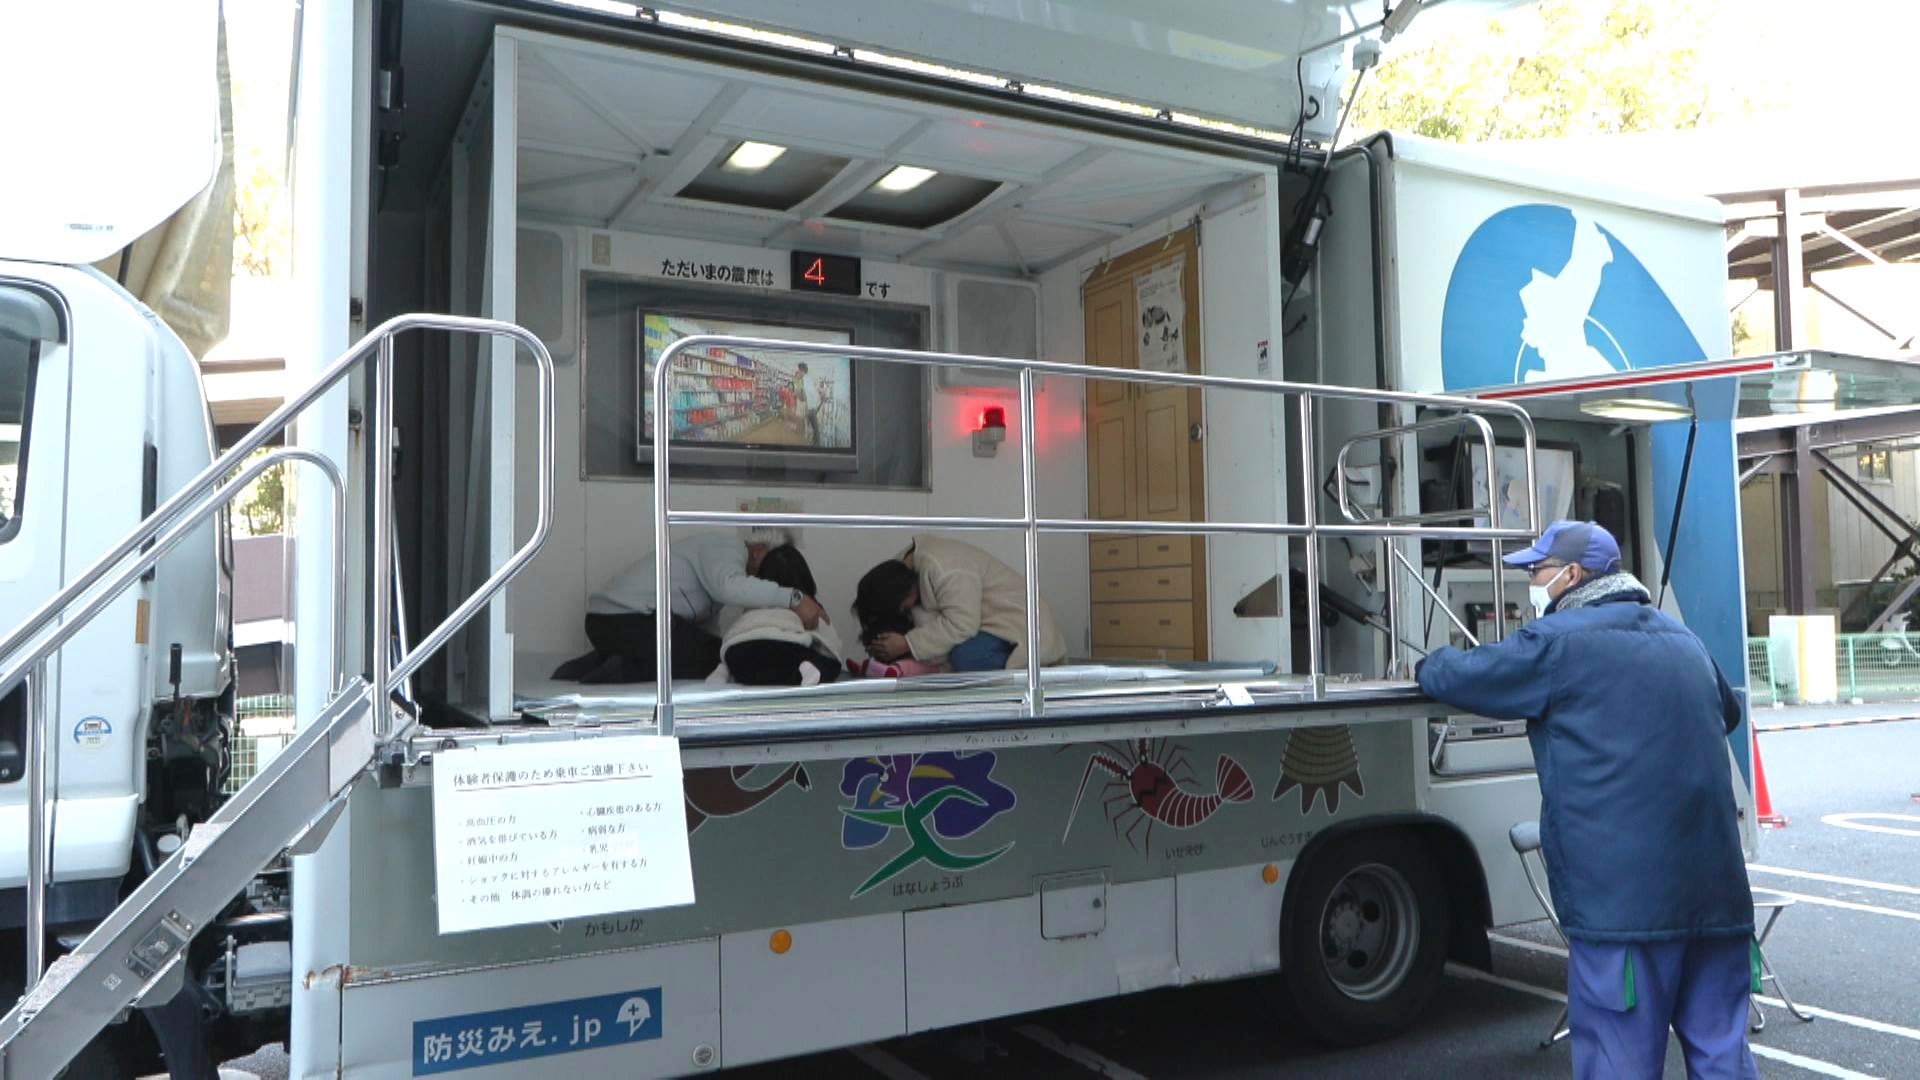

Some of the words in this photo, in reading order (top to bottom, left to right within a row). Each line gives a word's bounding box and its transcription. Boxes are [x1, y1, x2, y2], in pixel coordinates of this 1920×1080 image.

[662, 258, 774, 287] ただいまの震度は
[803, 256, 825, 287] 4
[866, 282, 891, 299] です
[453, 762, 650, 787] 体験者保護のため乗車ご遠慮下さい
[892, 875, 964, 897] はなしょうぶ
[584, 918, 645, 937] かもしか
